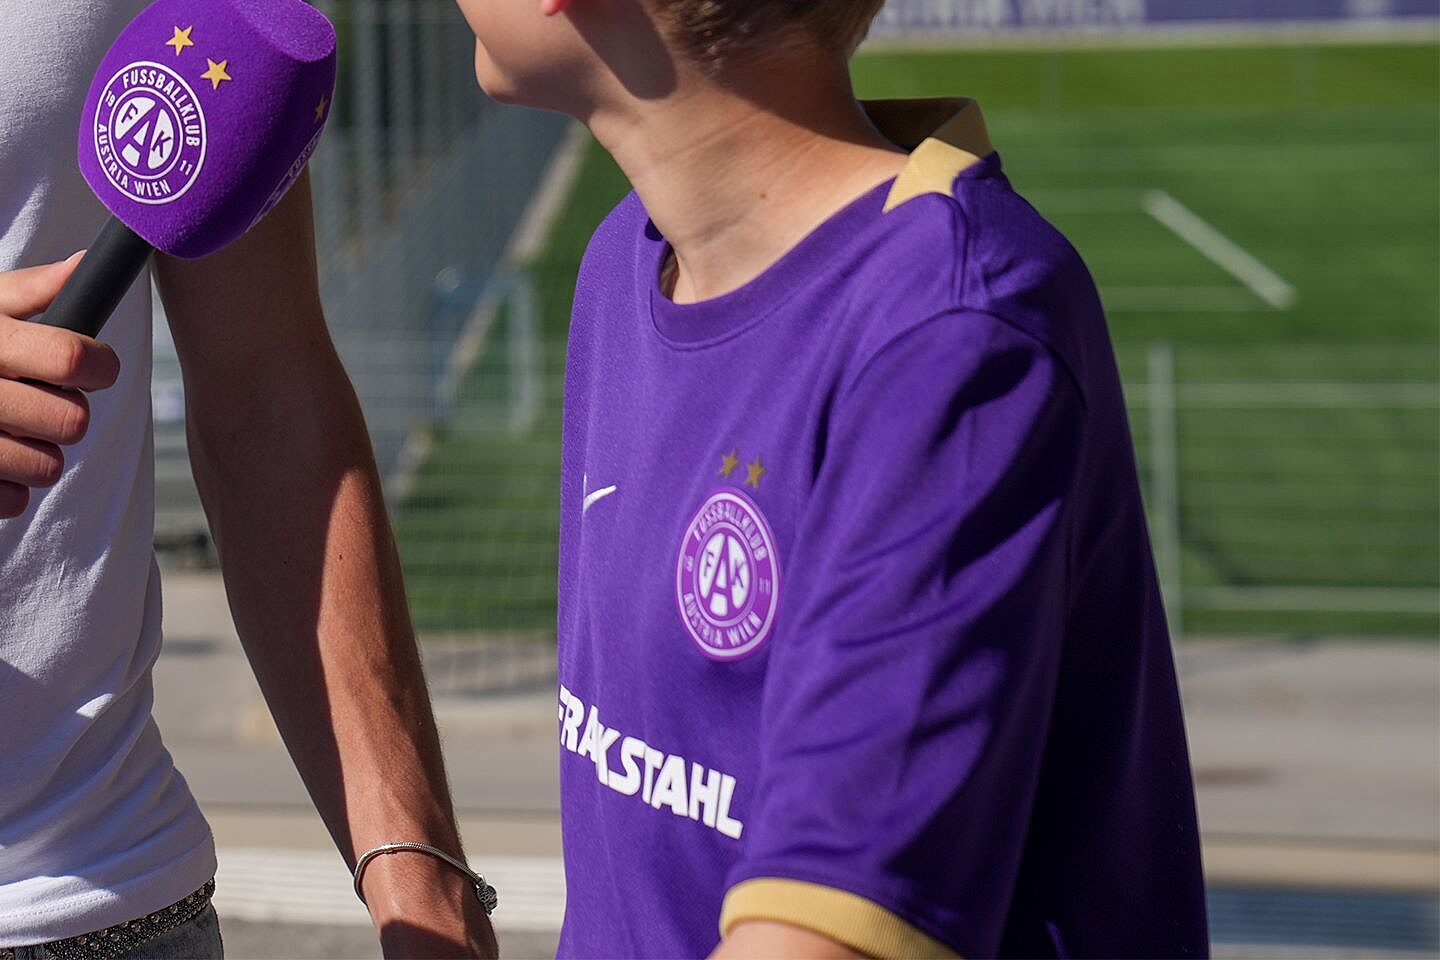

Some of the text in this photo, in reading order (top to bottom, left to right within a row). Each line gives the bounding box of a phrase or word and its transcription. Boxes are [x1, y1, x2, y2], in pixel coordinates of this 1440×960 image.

[105, 90, 116, 108] 19
[122, 69, 201, 147] FUSSBALLKLUB
[98, 123, 172, 197] AUSTRIA WIEN
[179, 160, 193, 176] 11
